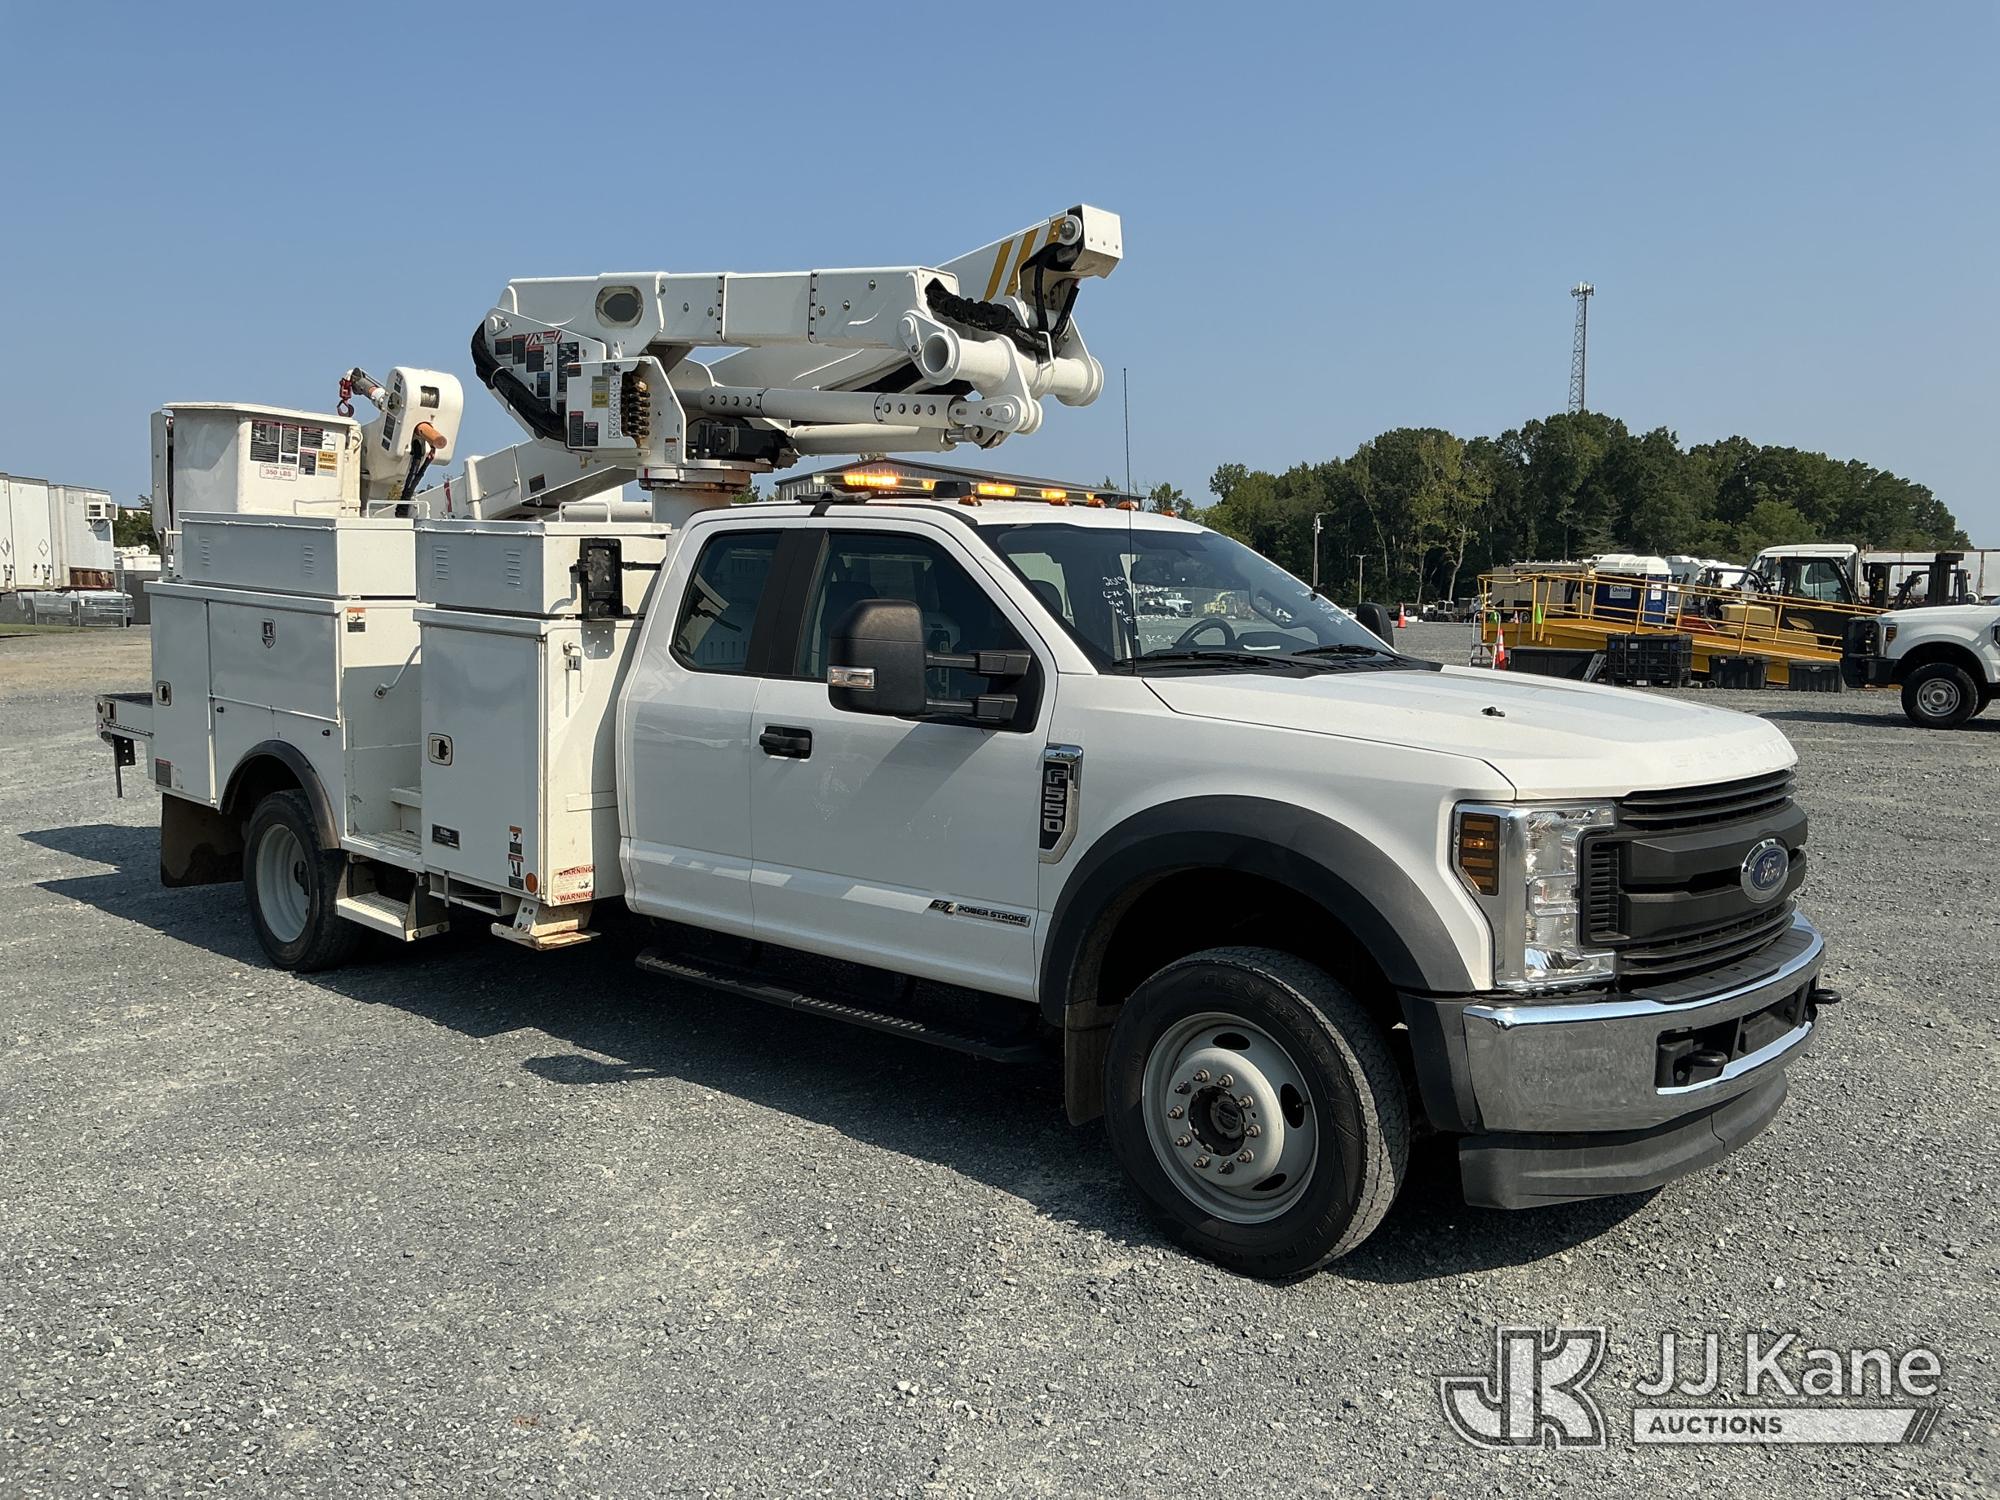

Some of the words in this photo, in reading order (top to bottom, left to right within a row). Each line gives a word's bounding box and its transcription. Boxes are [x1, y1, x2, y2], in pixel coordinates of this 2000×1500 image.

[1760, 856, 1781, 884] Ford
[560, 890, 594, 901] WARNING
[958, 904, 989, 916] POWER
[990, 911, 1027, 924] STROKE
